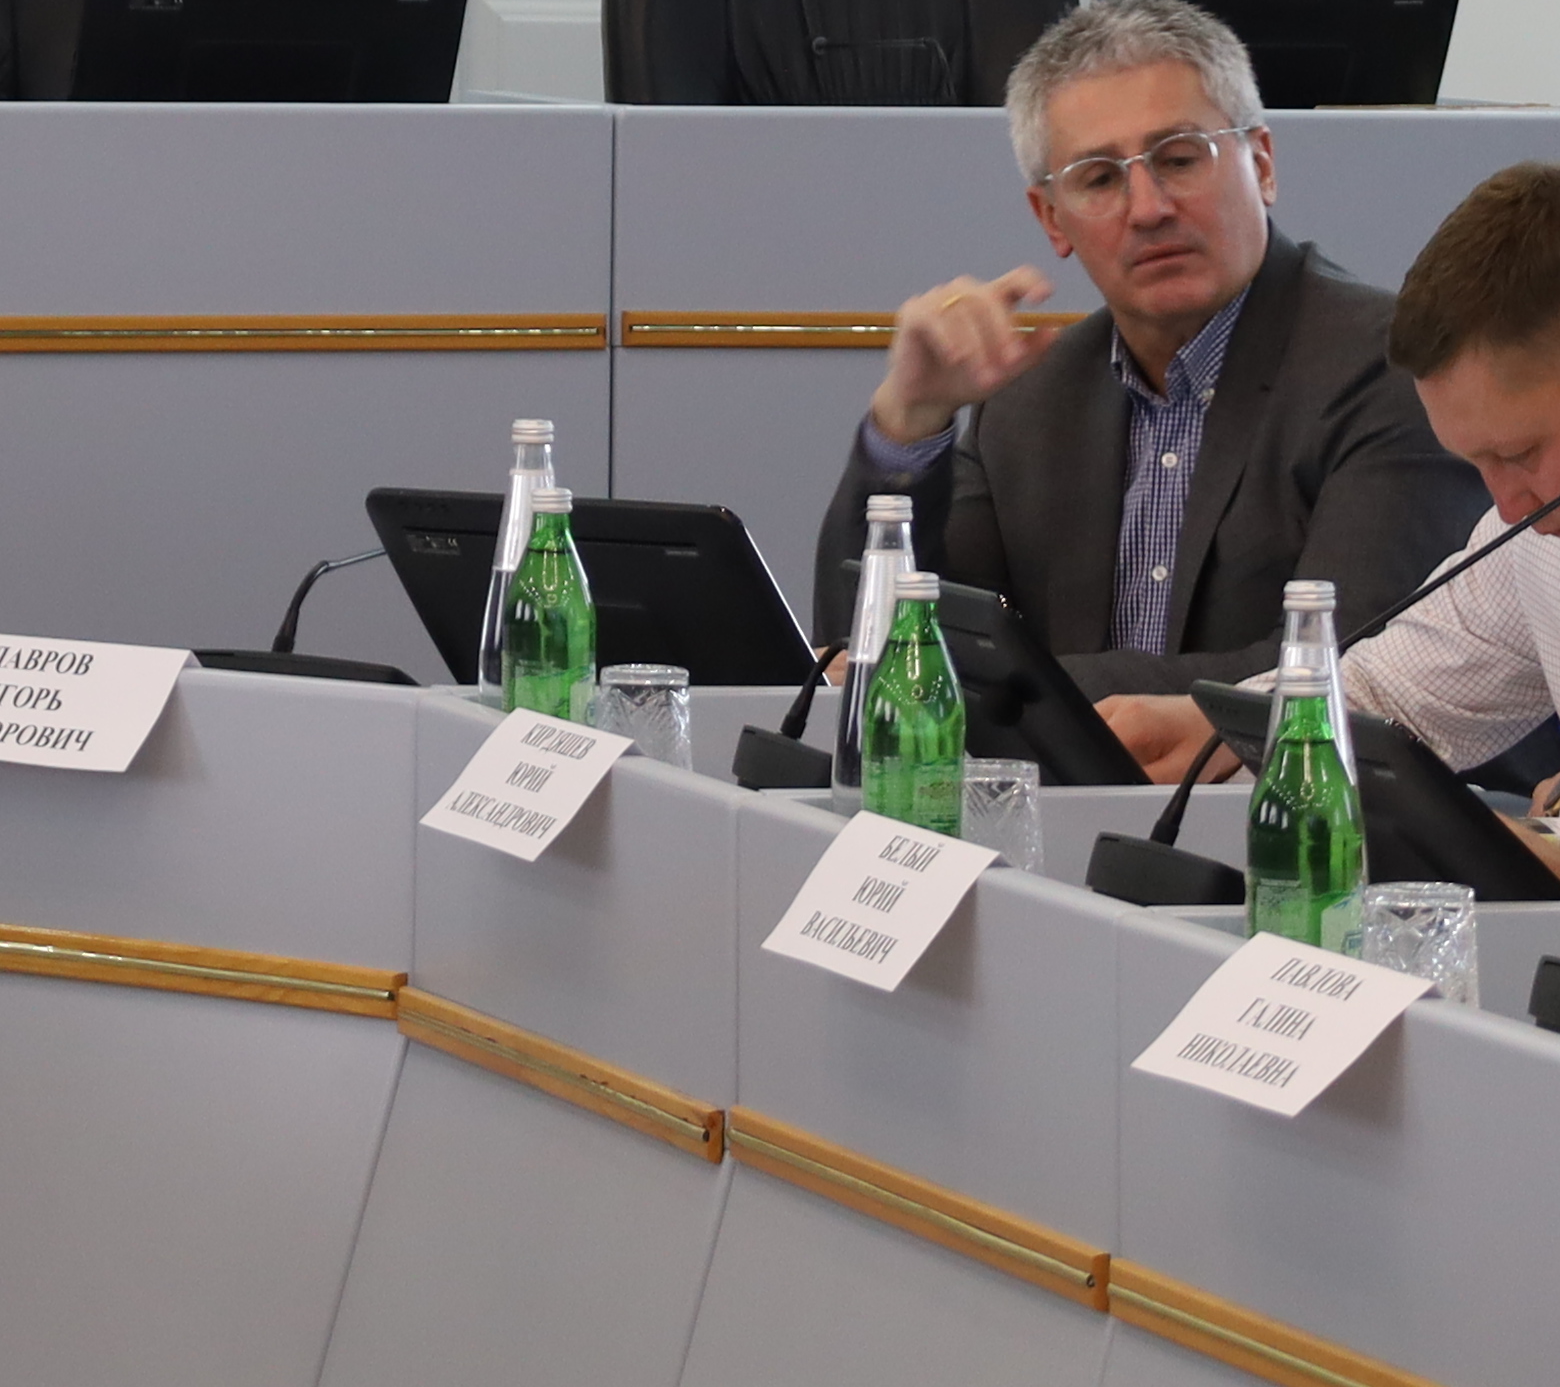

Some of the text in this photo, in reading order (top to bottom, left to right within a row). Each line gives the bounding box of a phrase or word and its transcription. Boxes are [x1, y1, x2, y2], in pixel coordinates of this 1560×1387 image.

[520, 722, 597, 761] КИРДЯШЕВ
[505, 761, 557, 793] ЮРИЙ
[446, 790, 558, 840] АЛЕКСАНДРОВИЧ
[878, 835, 945, 873] БЕЛЫЙ
[852, 876, 908, 914] ЮРИЙ
[800, 910, 899, 965] ВАСИЛЬЕВИЧ
[1270, 957, 1364, 1002] ПАВЛОВА
[1237, 997, 1318, 1041] ГАЛИНА
[1177, 1032, 1301, 1089] НИКОЛАЕВНА
